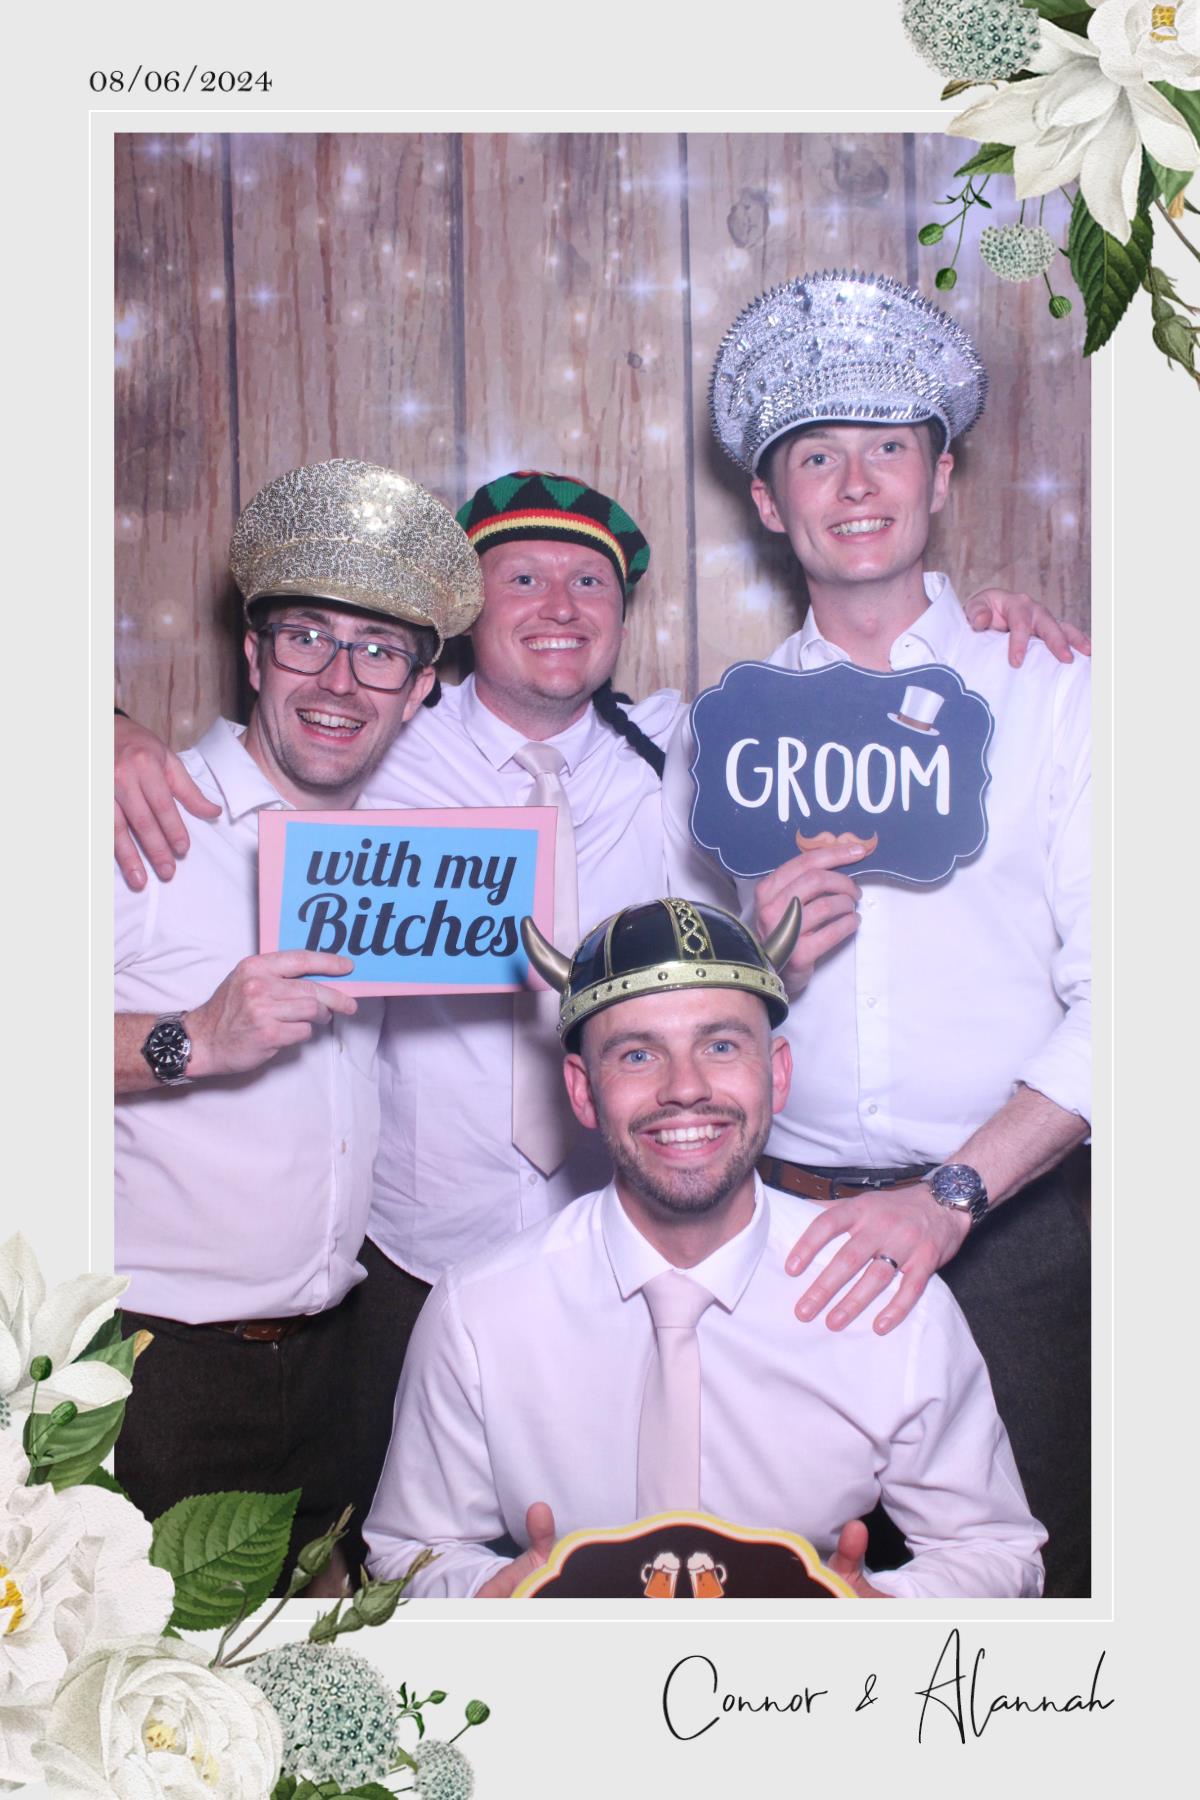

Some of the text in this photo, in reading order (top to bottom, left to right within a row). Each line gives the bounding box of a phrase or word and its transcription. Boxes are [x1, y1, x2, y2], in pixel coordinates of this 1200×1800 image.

[725, 736, 951, 823] GROOM
[306, 837, 518, 906] with my
[297, 892, 519, 957] Bitches
